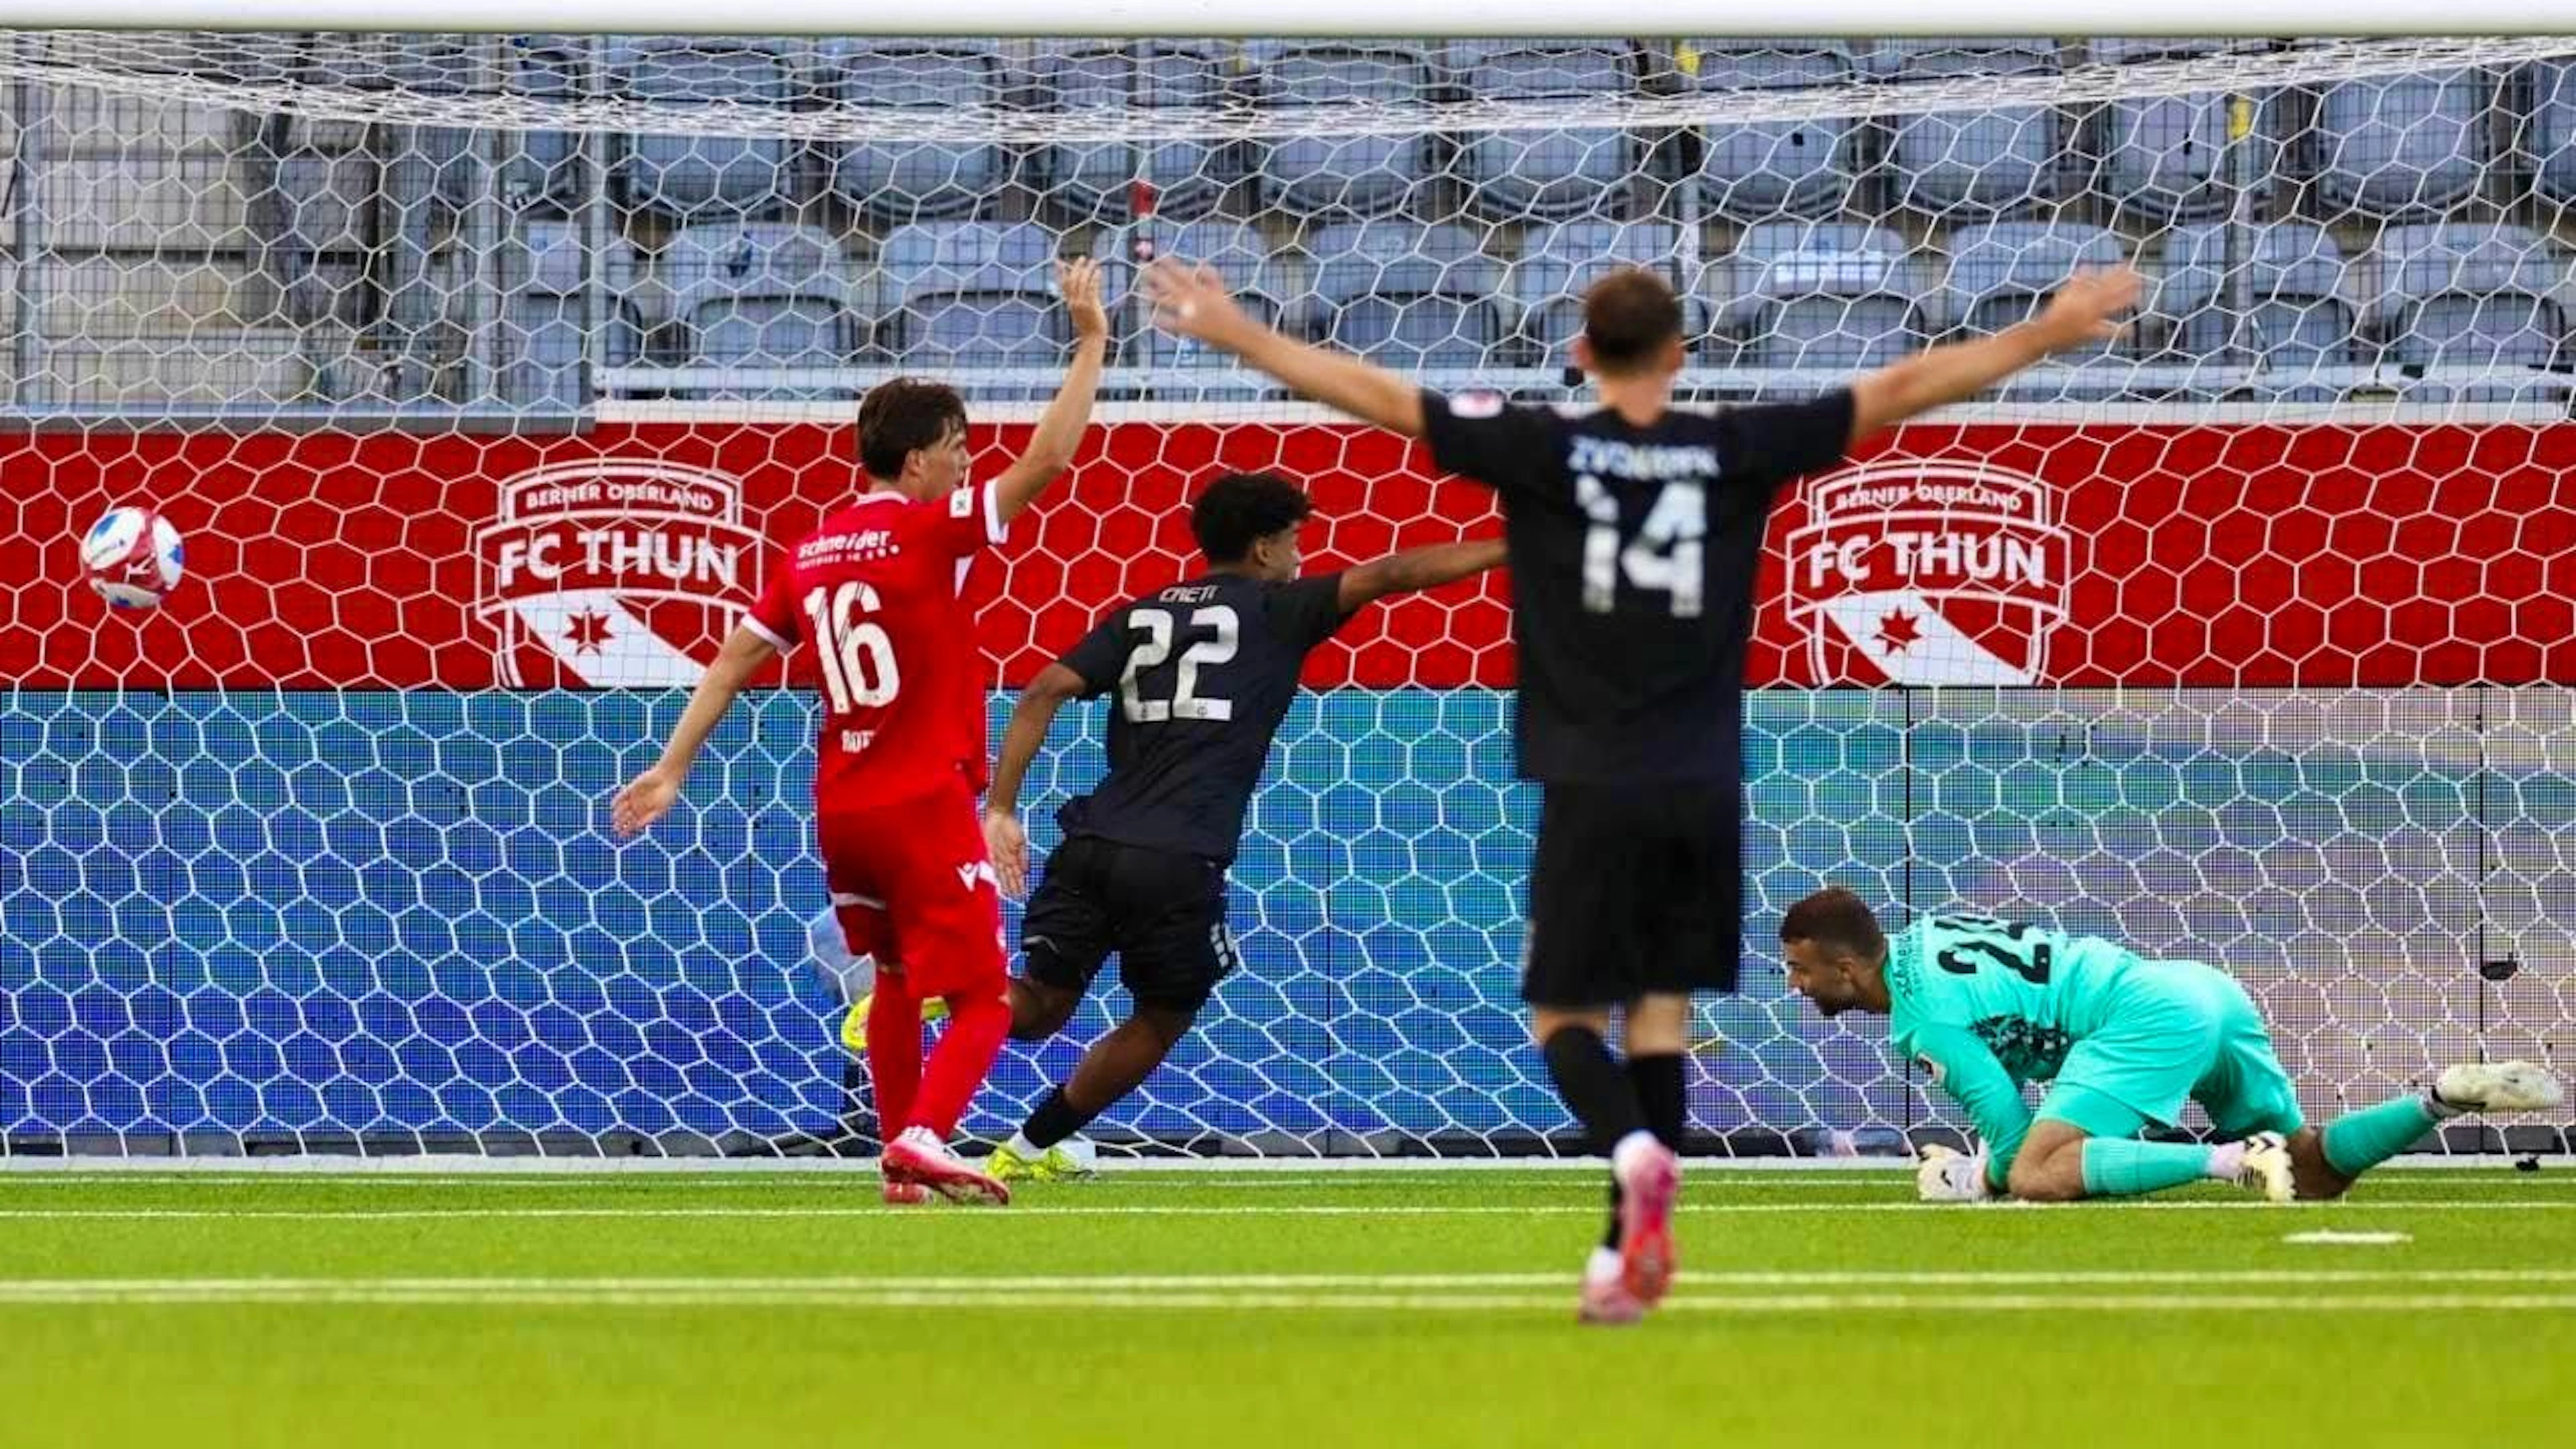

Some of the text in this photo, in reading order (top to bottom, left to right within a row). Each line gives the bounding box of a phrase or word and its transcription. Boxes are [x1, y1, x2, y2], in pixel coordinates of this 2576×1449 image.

[526, 484, 714, 511] BERNER OBERLAND
[1836, 485, 2021, 511] BERNER OBERLAND
[499, 530, 736, 588] FC THUN
[1576, 474, 1707, 618] 14
[1811, 531, 2046, 588] FC THUN
[803, 580, 901, 714] 16
[1120, 604, 1239, 723] 22
